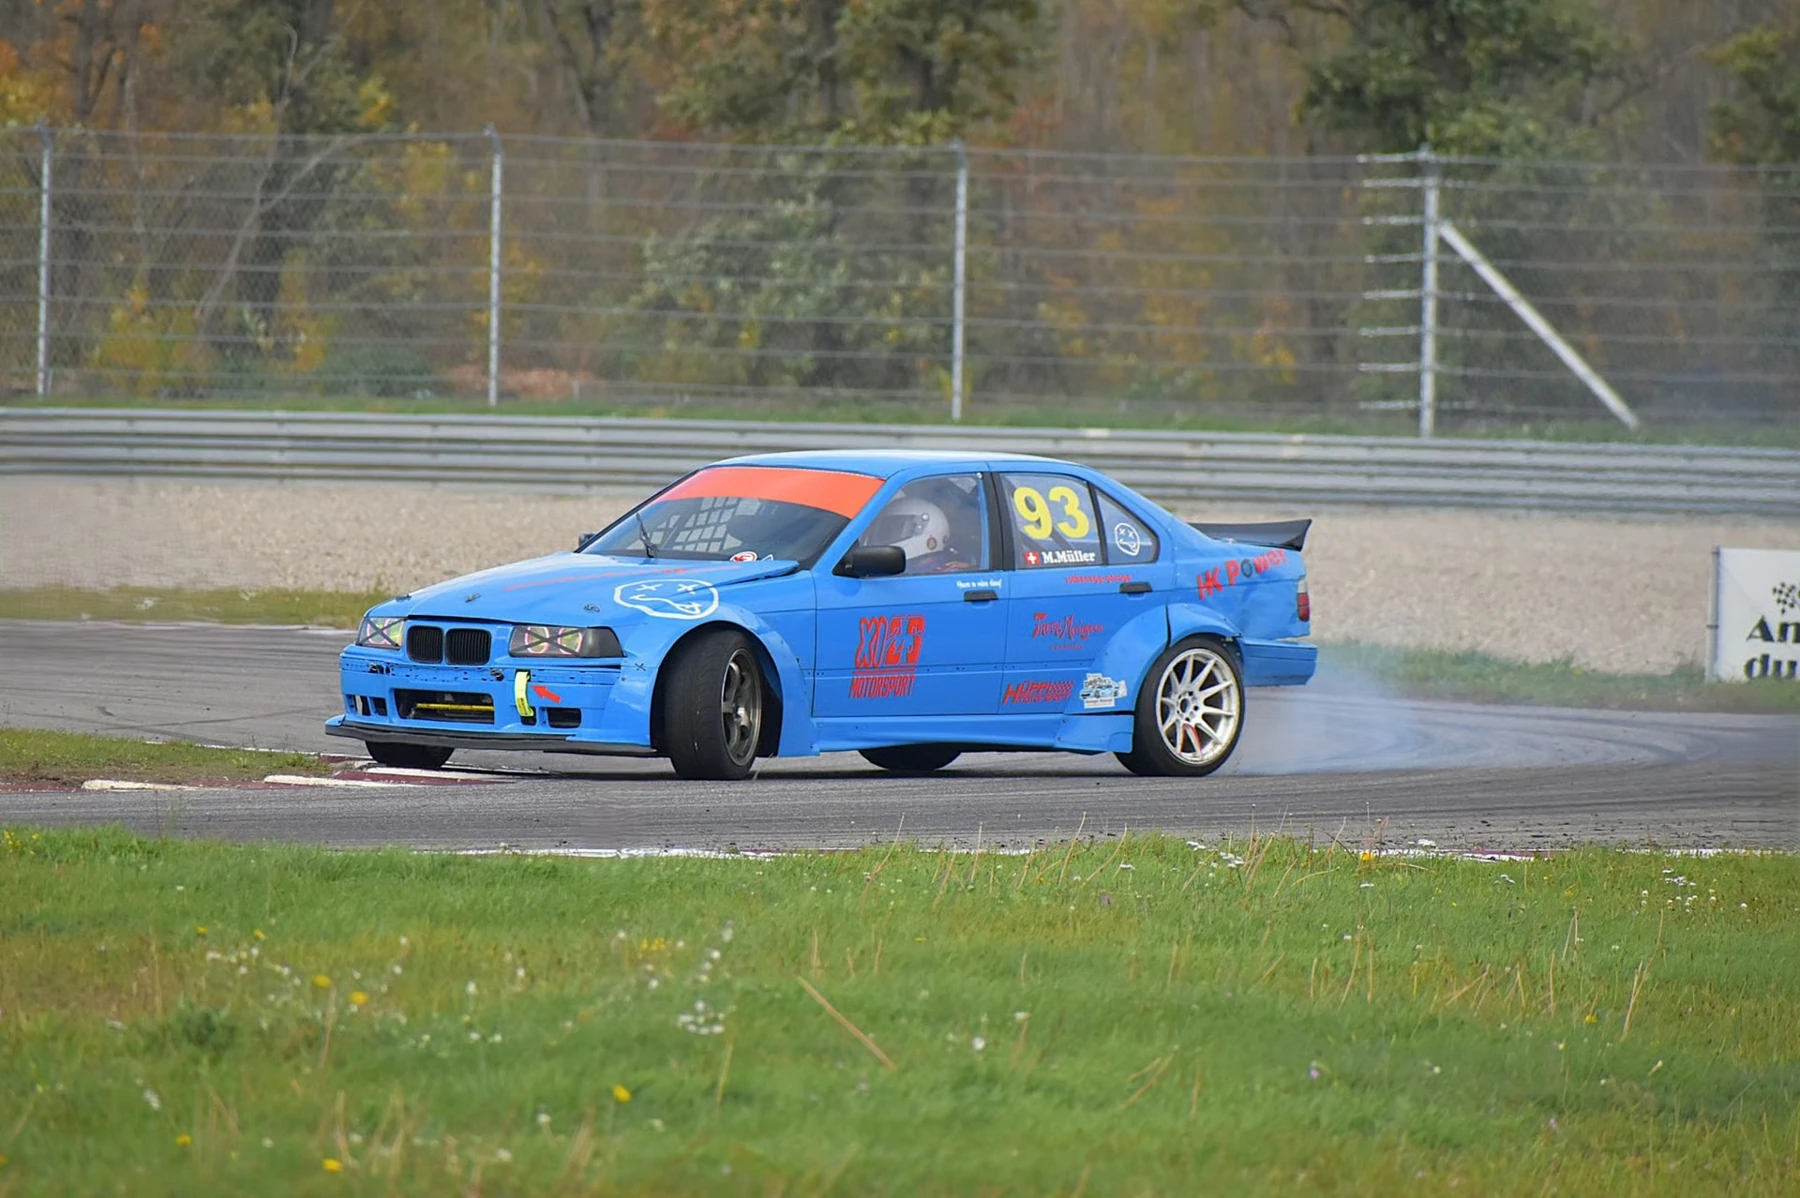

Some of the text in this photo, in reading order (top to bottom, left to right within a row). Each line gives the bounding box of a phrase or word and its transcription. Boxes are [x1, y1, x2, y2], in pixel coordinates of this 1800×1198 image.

[1013, 486, 1090, 540] 93
[1042, 550, 1096, 564] M.Müller
[1225, 548, 1288, 587] Power
[1743, 653, 1798, 680] du
[849, 674, 917, 699] MOTORSPORT
